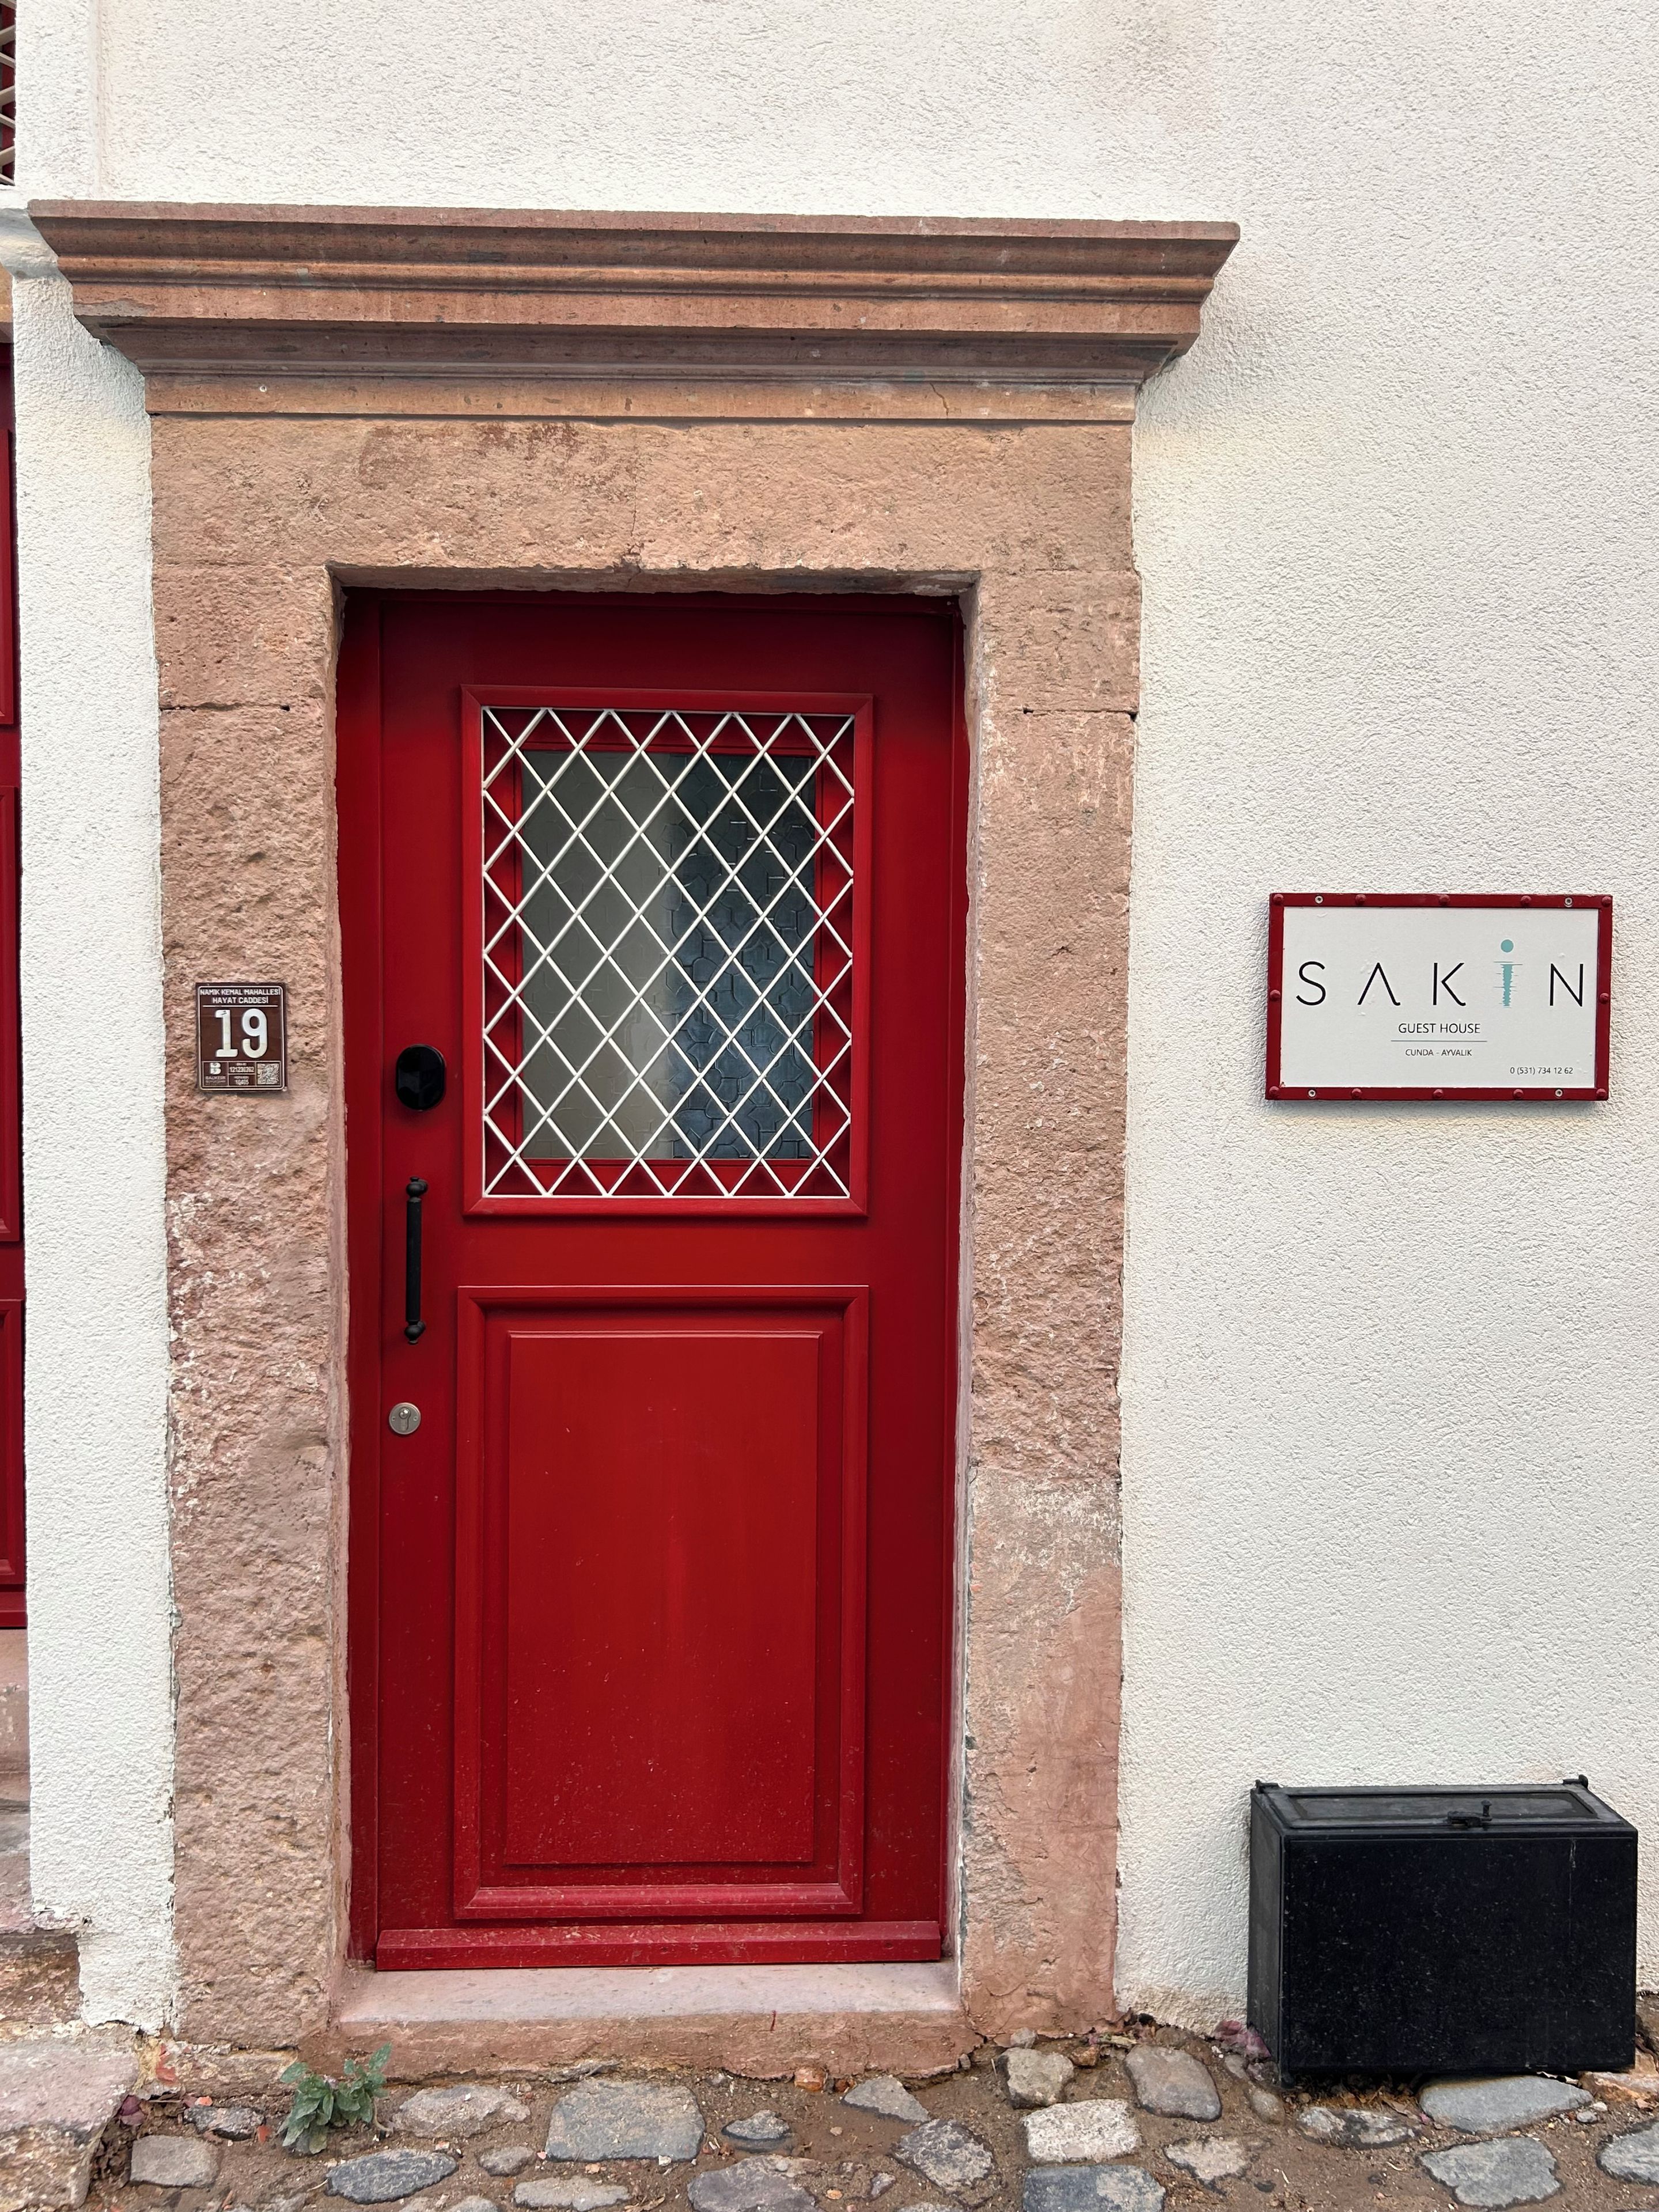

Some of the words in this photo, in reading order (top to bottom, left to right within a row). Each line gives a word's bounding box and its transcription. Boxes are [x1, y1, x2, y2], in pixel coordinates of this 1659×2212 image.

[215, 1008, 267, 1058] 19
[1398, 1023, 1437, 1033] GUEST
[1440, 1023, 1480, 1034] HOUSE
[1405, 1048, 1434, 1056] CUNDA
[1517, 1067, 1536, 1075] (531)
